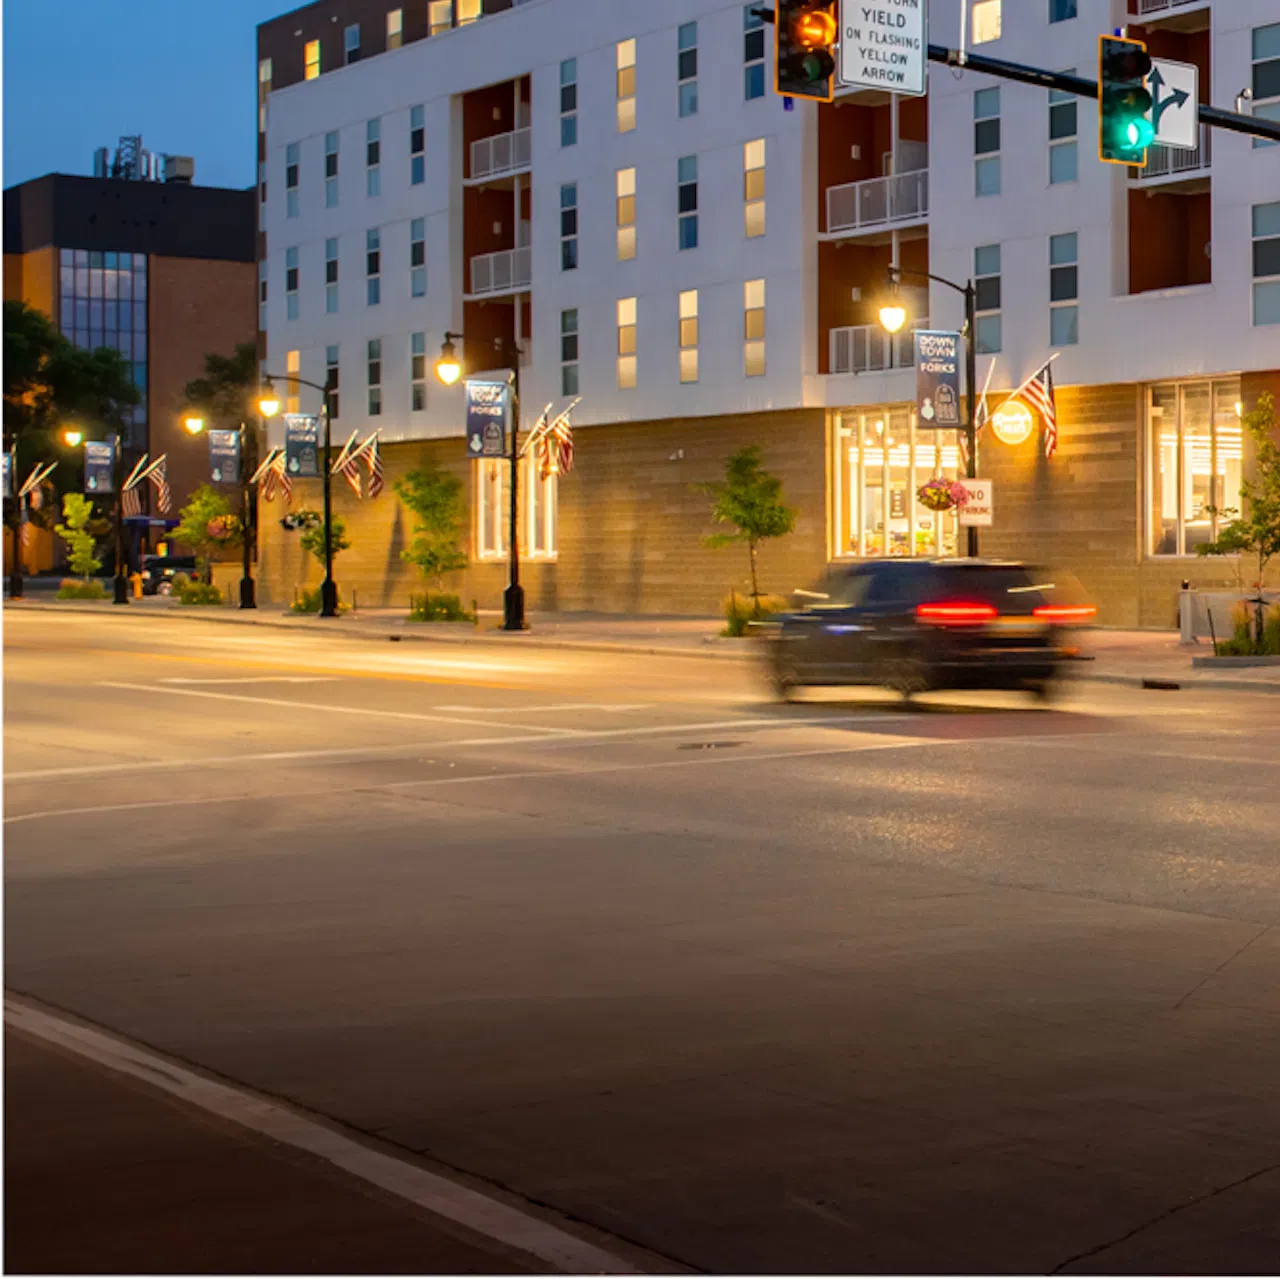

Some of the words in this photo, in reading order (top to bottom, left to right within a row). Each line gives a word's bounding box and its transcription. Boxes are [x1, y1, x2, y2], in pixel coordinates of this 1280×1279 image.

[861, 7, 907, 28] YIELD
[846, 26, 861, 39] ON
[868, 31, 920, 50] FLASHING
[858, 47, 908, 65] YELLOW
[861, 67, 905, 83] ARROW
[968, 489, 984, 501] NO
